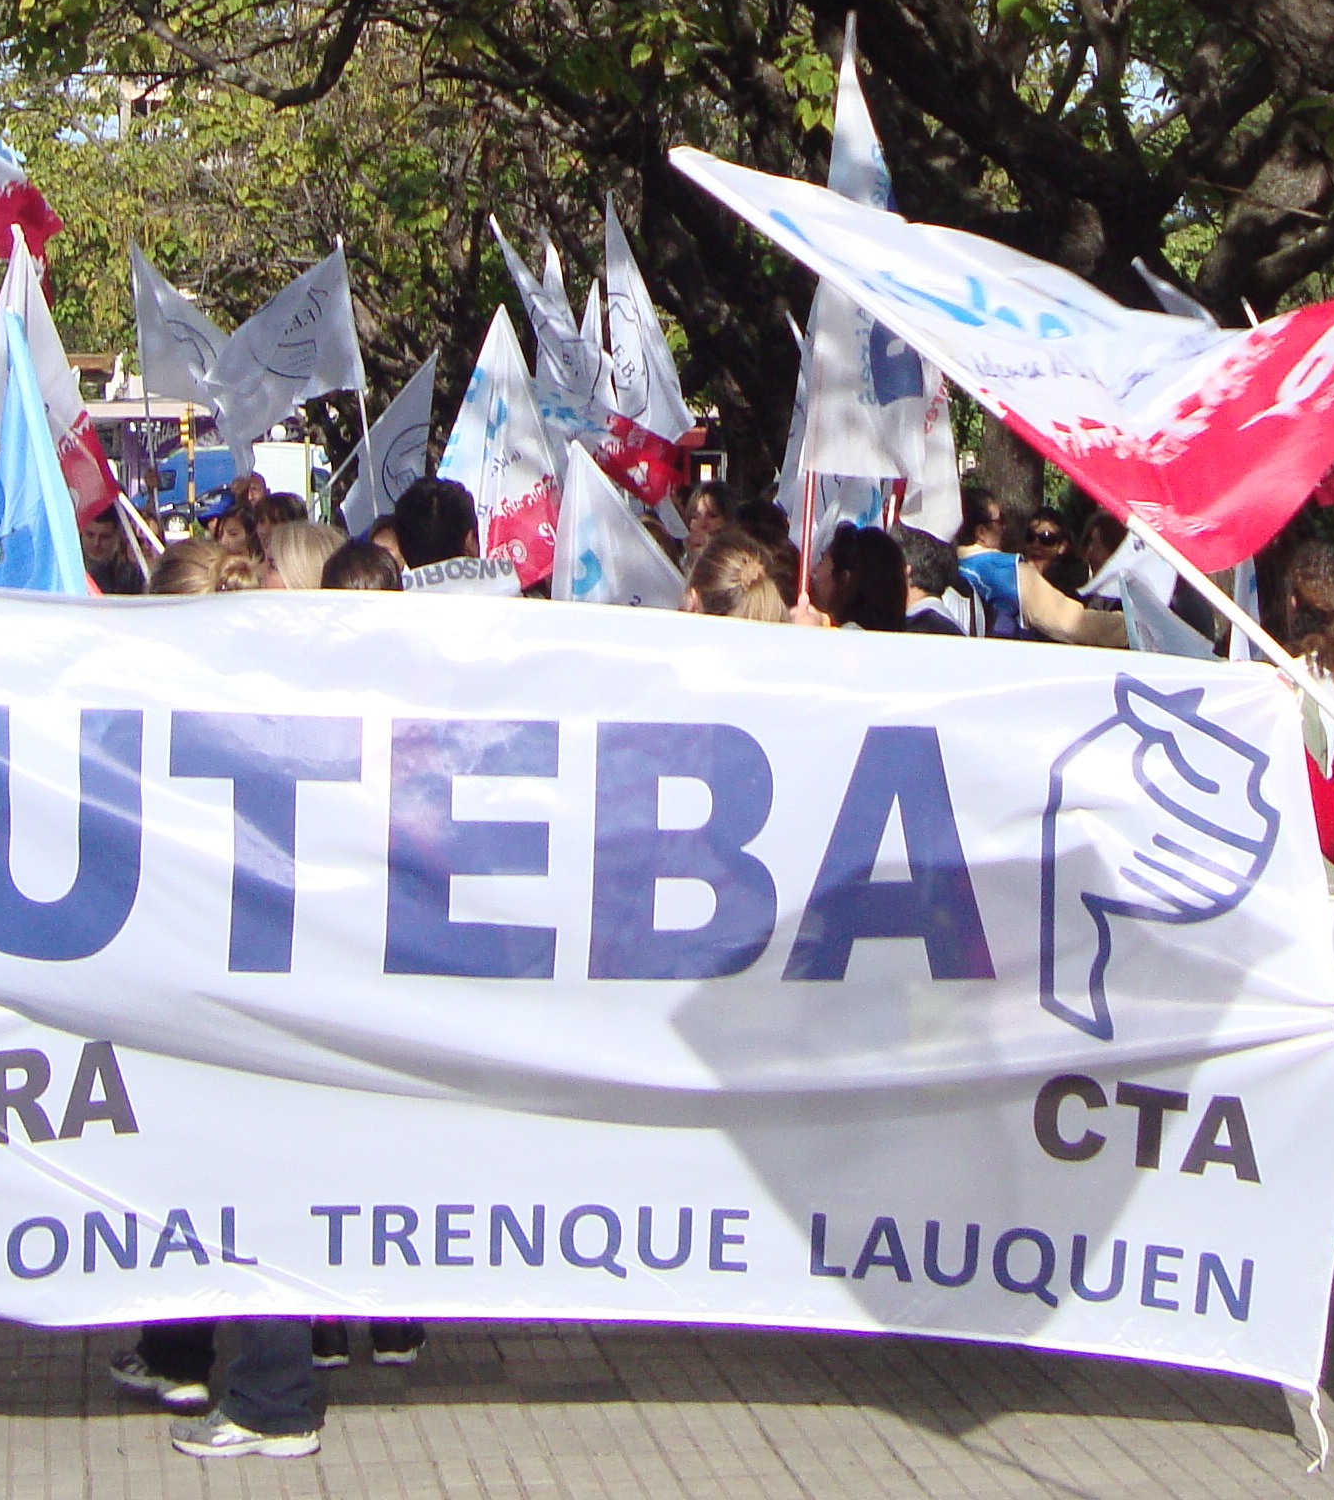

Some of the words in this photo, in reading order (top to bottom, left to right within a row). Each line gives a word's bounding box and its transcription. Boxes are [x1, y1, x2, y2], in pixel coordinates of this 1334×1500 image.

[1033, 1073, 1262, 1185] CTA
[310, 1203, 751, 1279] TRENQUE
[809, 1212, 1255, 1323] LAUQUEN
